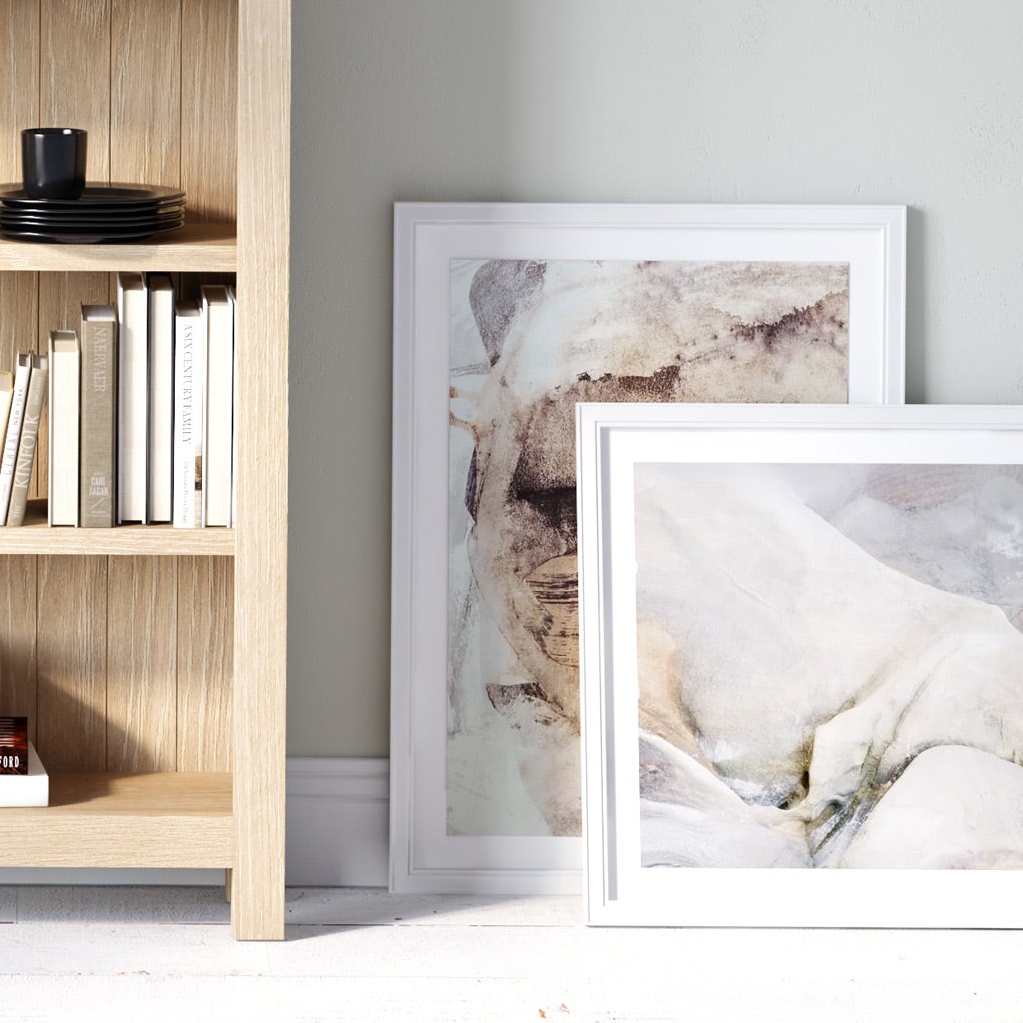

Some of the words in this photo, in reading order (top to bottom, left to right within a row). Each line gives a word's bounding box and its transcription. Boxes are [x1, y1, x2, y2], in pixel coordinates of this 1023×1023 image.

[184, 332, 193, 349] SIX
[183, 351, 193, 402] CENTURY
[3, 431, 19, 476] CEREAL
[16, 388, 24, 408] YORK
[182, 404, 192, 445] FAMILY
[15, 414, 40, 488] KINFOLK
